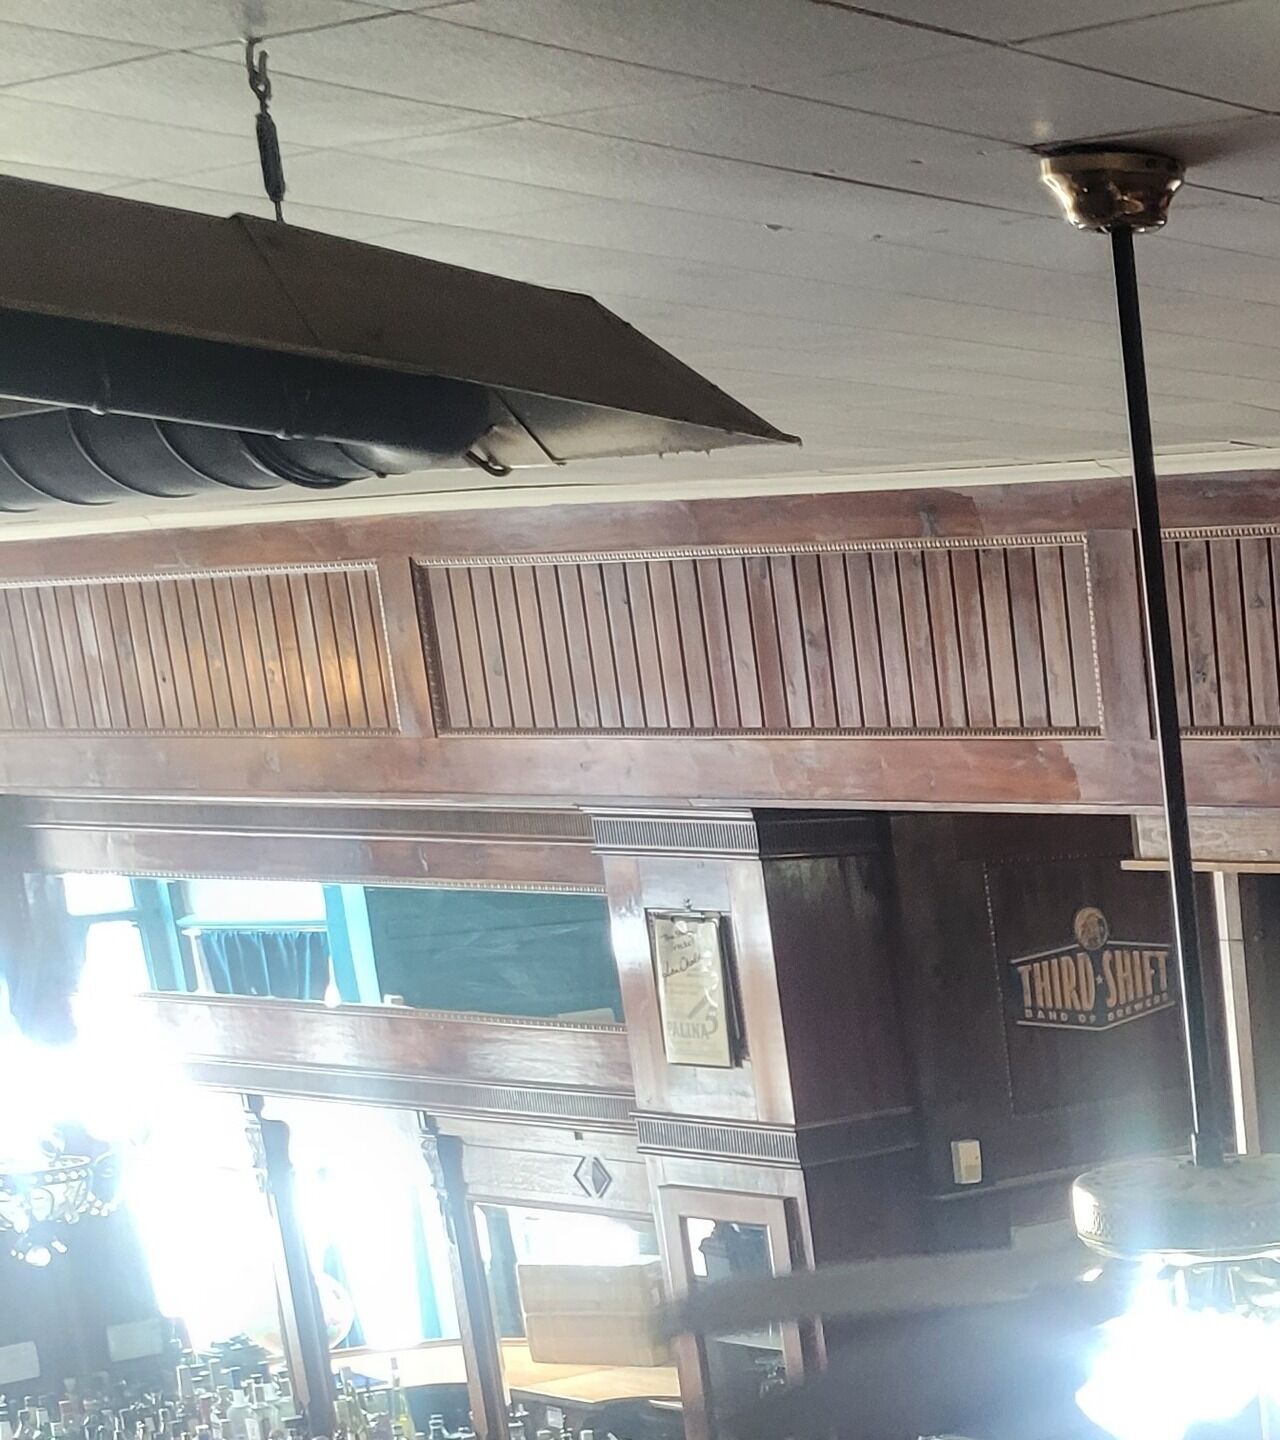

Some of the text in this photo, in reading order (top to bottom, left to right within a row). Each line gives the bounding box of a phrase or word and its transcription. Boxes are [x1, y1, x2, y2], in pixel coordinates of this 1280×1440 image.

[1017, 949, 1169, 1012] THIRD SHIFT
[1024, 1008, 1070, 1023] BAND
